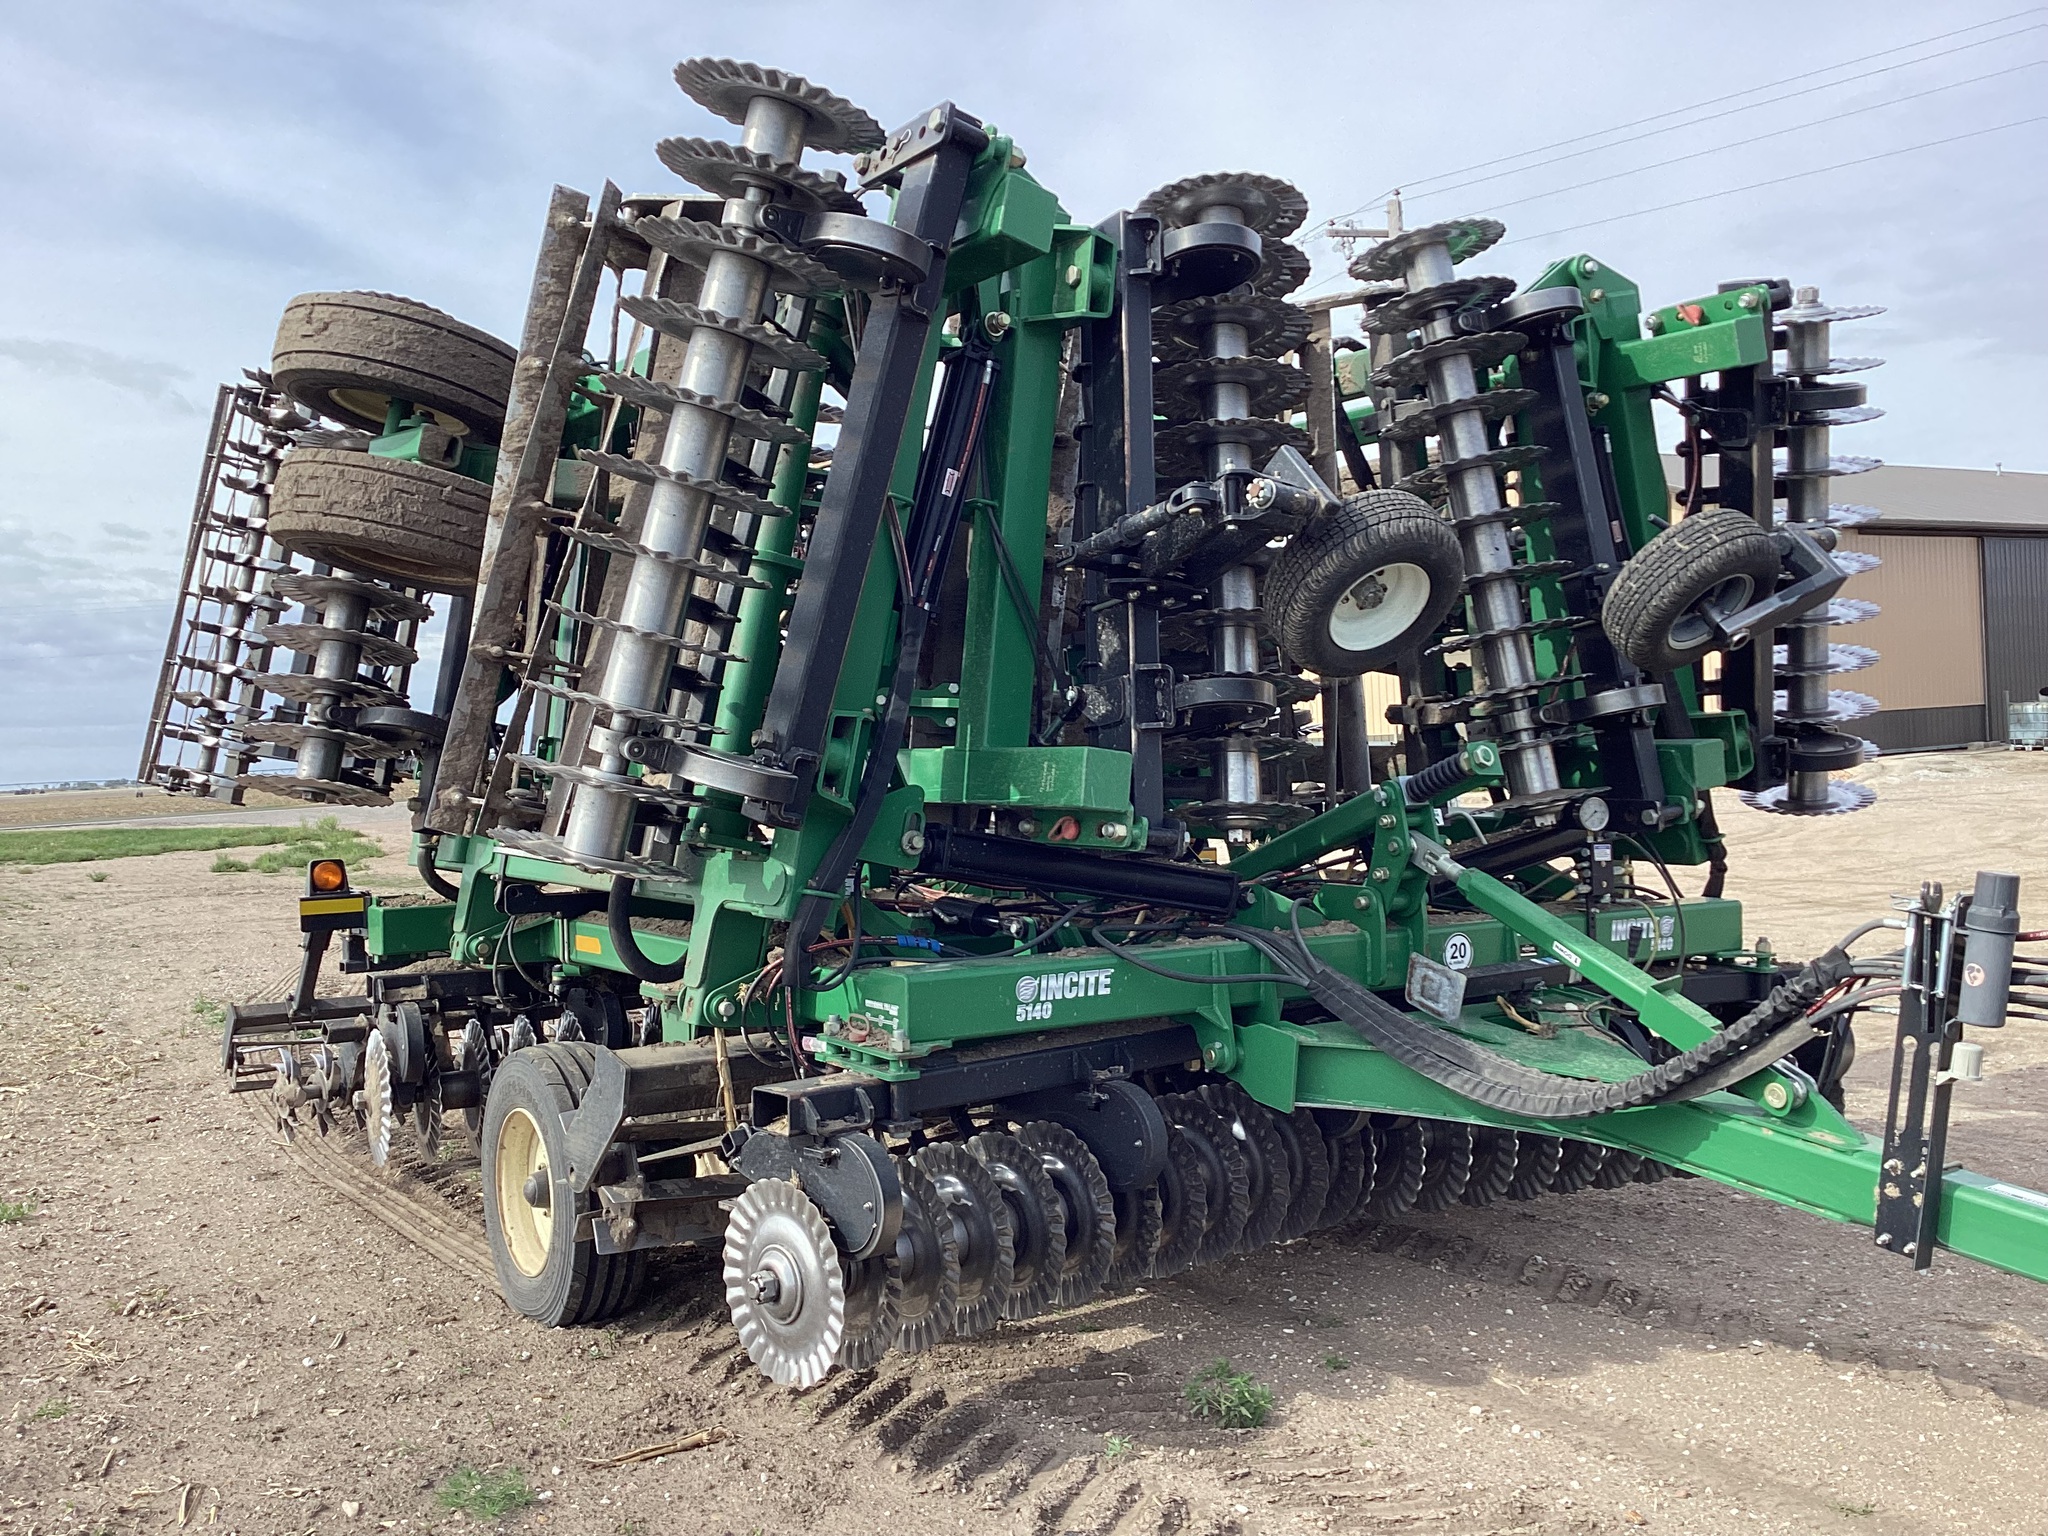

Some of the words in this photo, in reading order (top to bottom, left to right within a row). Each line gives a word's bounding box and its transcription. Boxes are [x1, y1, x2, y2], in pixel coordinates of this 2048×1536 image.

[1611, 917, 1657, 941] INCTE
[1450, 943, 1466, 959] 20
[1040, 968, 1112, 1001] INCITE
[1016, 1002, 1052, 1021] 5140
